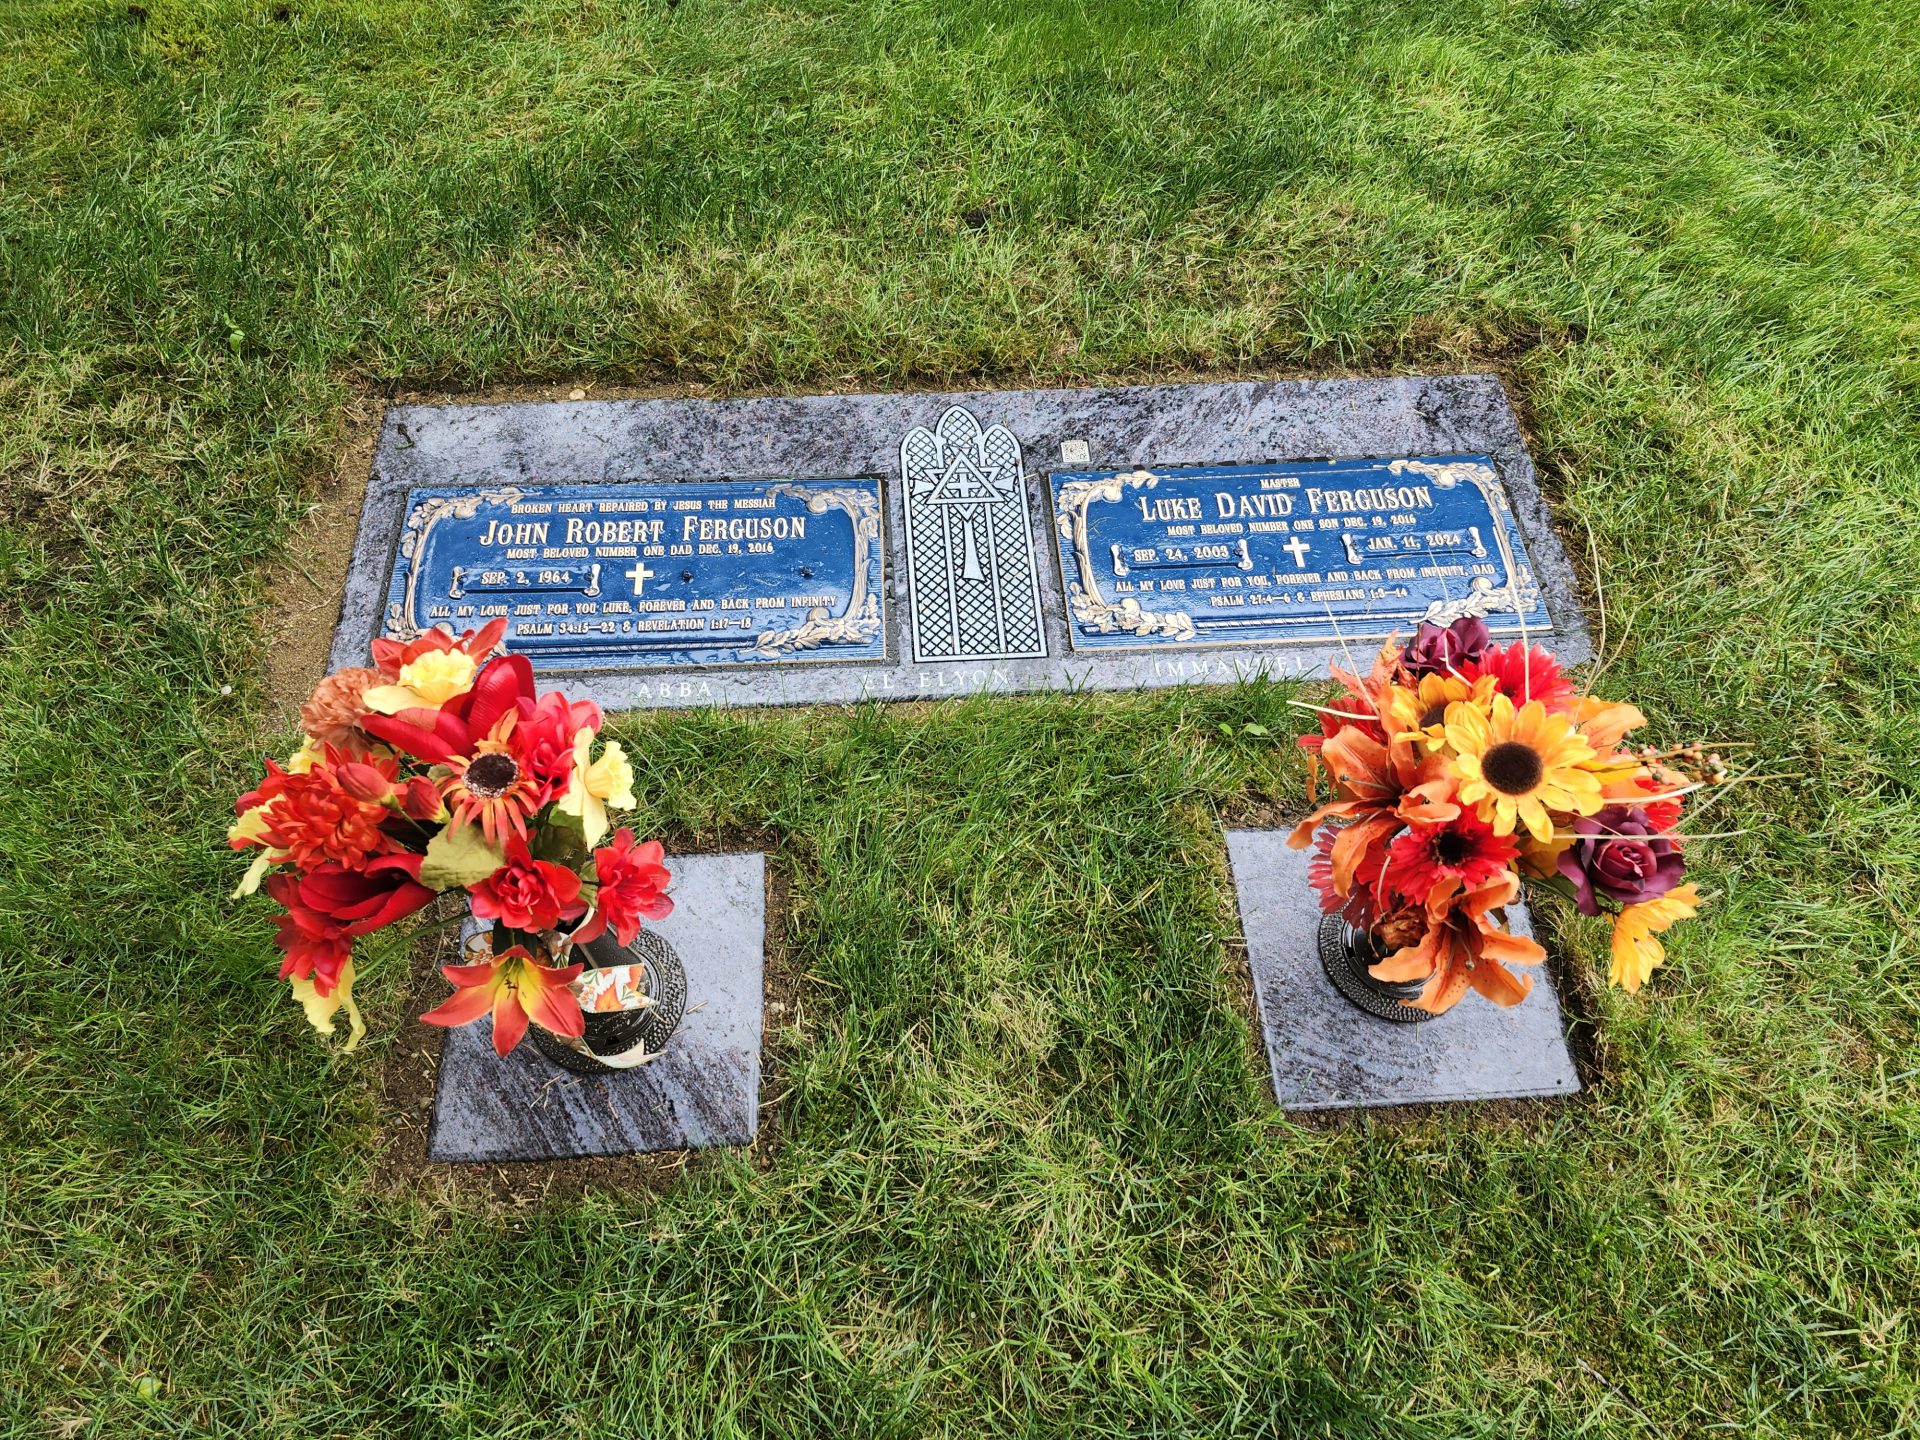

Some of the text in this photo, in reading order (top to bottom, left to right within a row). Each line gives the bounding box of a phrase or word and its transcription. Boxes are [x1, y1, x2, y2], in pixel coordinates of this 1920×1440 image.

[1260, 478, 1300, 489] MASTER
[511, 498, 775, 514] BROKEN HEART REPAIRED BY JESUS THE MESSIAH
[1139, 485, 1433, 521] LUKE DAVID FERGUSON
[479, 515, 806, 546] JOHN ROBERT FERGUSON
[1167, 514, 1416, 536] MOST BELOVED NUMBER ONE SON DEC. 19, 2016
[1368, 533, 1461, 549] JAN. 11, 2024
[506, 542, 773, 559] MOST BELOVED NUMBER ONE DAD DEC. 19, 2016
[1134, 545, 1229, 561] SEP. 24, 2003
[481, 570, 570, 585] SEP. 2, 1964
[1115, 564, 1495, 592] ALL MY LOVE JUST FOR YOU, FOREVER AND BACK FROM INFINITY, DAD
[1211, 595, 1245, 606] PSALM
[1311, 589, 1366, 602] EPHESIANS
[430, 596, 836, 617] ALL MY LOVE JUST FOR YOU LUKE, FOREVER AND BACK FROM INFINITY
[516, 623, 553, 635] PSALM
[637, 619, 704, 631] REVELATION
[638, 682, 712, 699] ABBA
